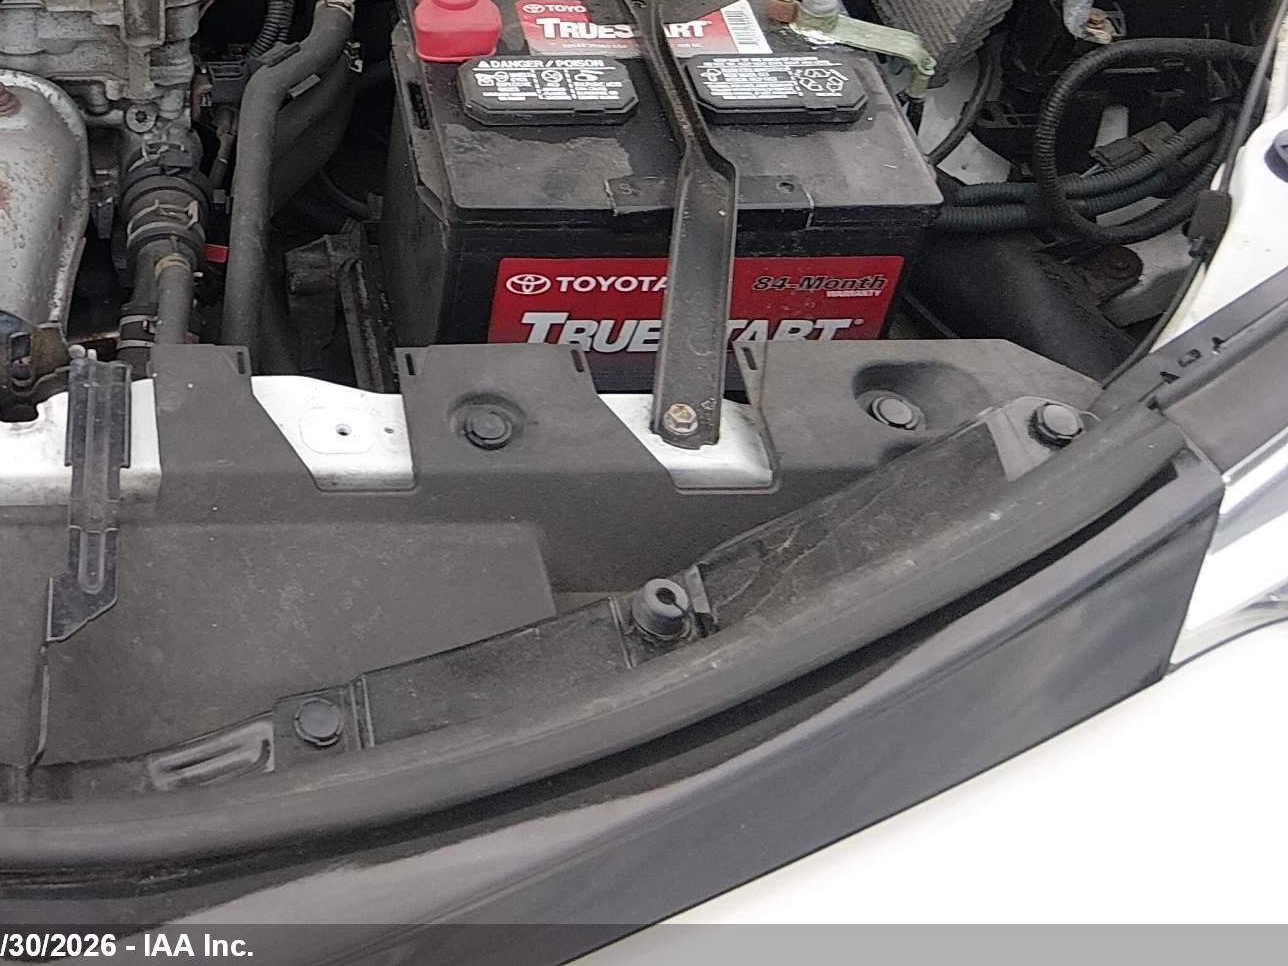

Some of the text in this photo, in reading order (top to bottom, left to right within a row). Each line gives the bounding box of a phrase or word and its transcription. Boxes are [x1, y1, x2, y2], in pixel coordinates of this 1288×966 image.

[545, 4, 587, 13] TOYO
[536, 17, 706, 39] TRUESRT
[489, 59, 544, 68] DANGER
[555, 59, 605, 68] POISON
[753, 274, 887, 291] 84-Month
